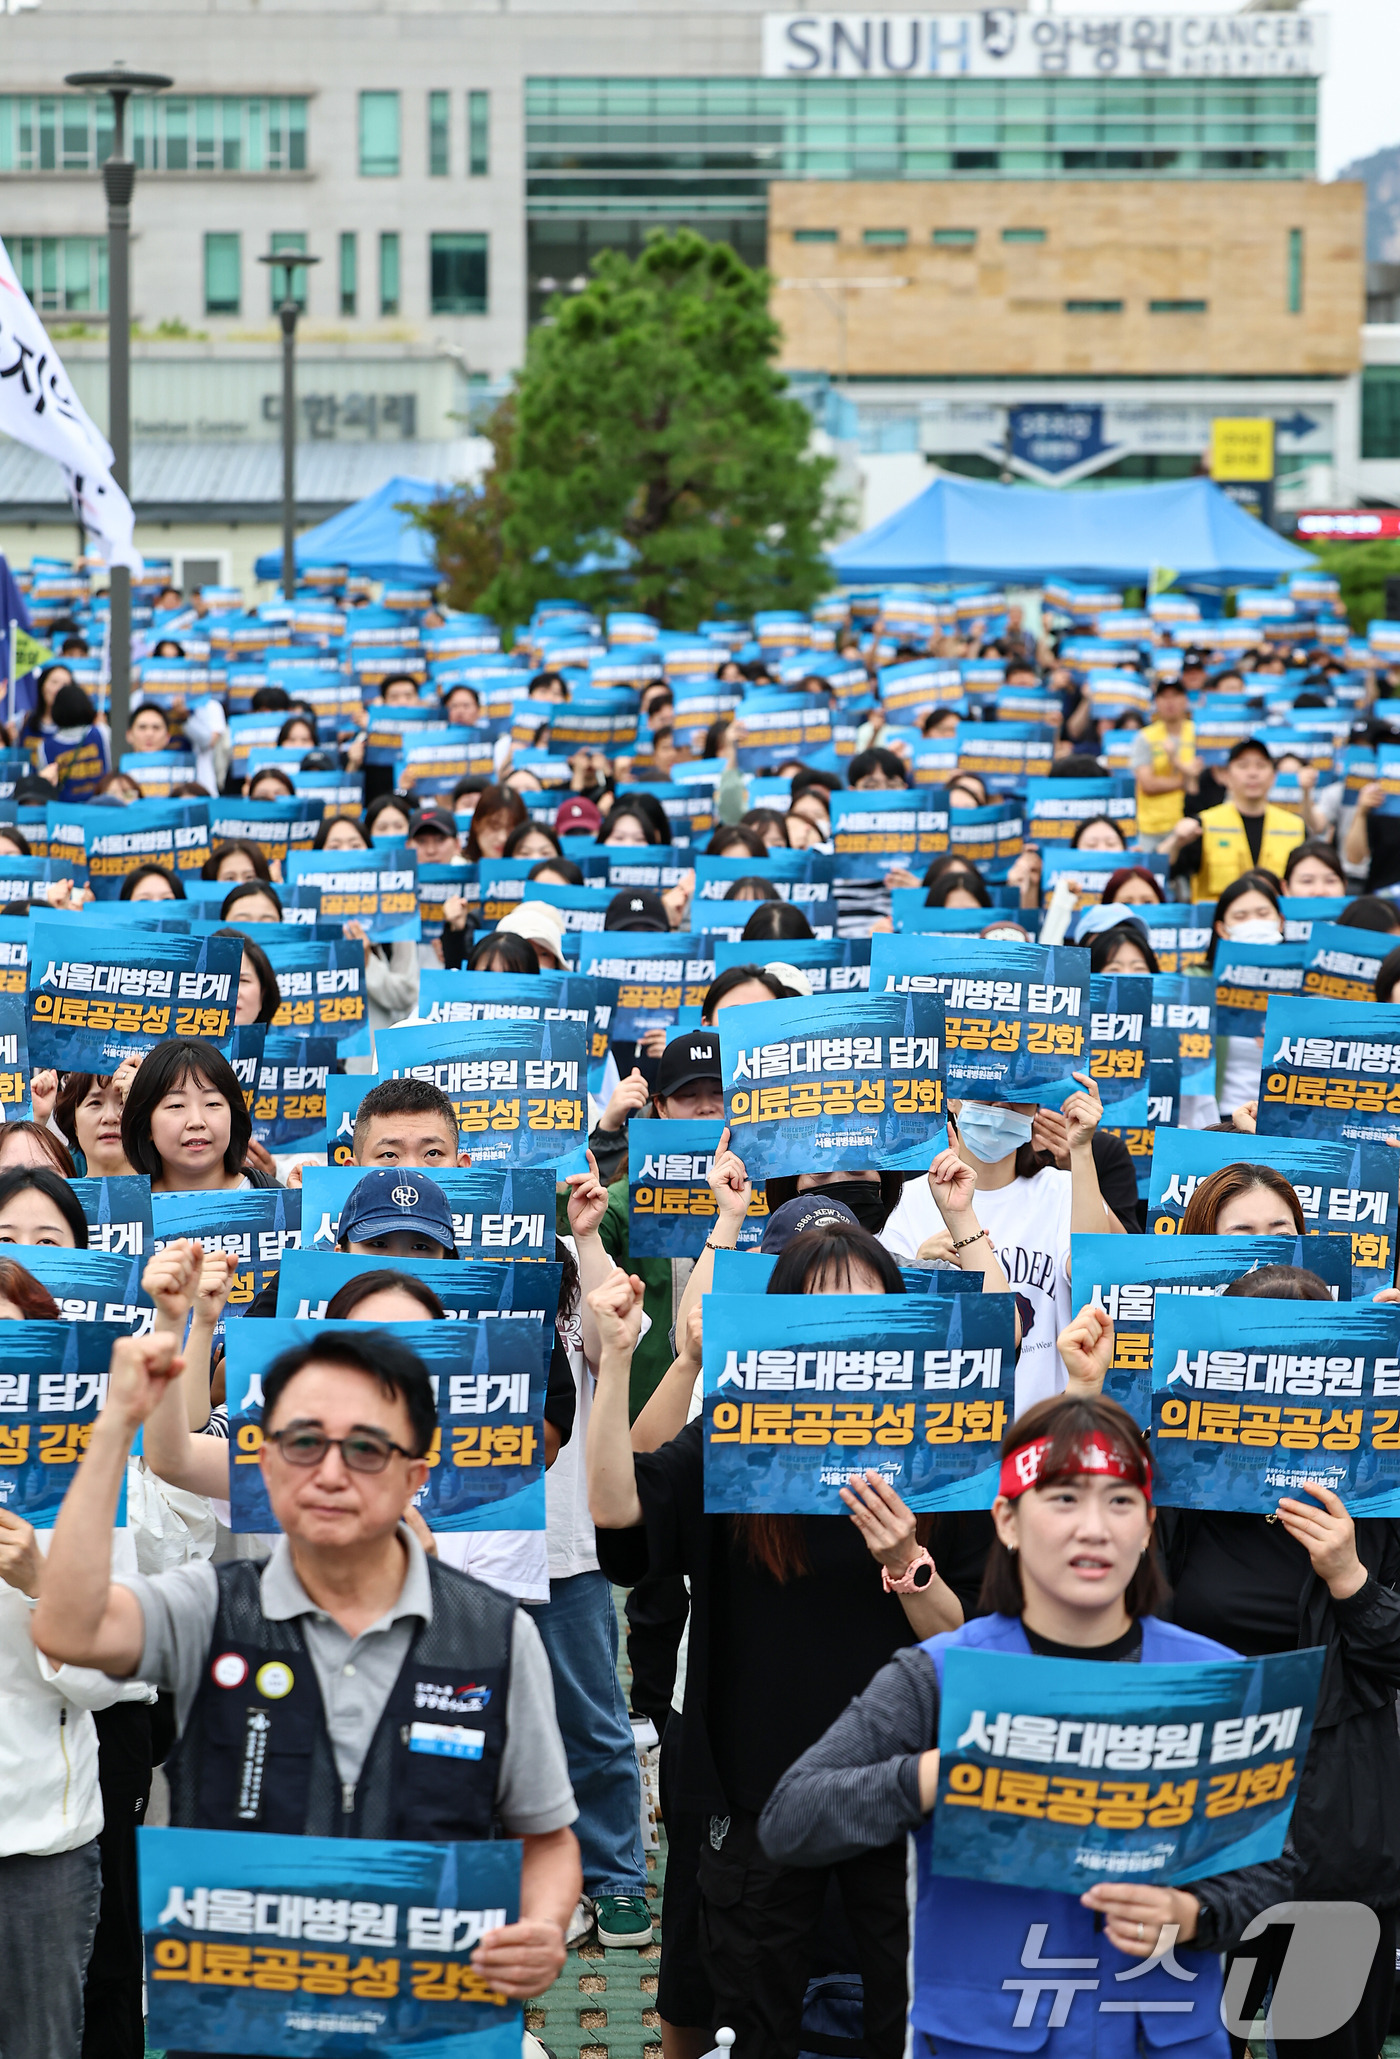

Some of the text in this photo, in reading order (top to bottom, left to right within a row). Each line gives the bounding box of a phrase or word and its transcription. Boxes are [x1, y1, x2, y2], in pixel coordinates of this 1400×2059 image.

[785, 17, 970, 72] SNUH
[1031, 18, 1170, 73] 암병원
[1180, 18, 1314, 49] CANCER
[1181, 51, 1312, 74] HOSPITAL
[90, 825, 208, 854] 서울대병원 답게
[378, 870, 414, 891] 답게
[320, 894, 378, 914] 공공성
[39, 961, 174, 998] 서울대병원
[177, 972, 232, 1001] 답게
[316, 968, 359, 993] 답게
[586, 958, 684, 982] 서울대병원
[830, 965, 871, 990] 답게
[319, 996, 365, 1022] 강화
[617, 985, 682, 1009] 공공성
[1027, 983, 1082, 1017] 답게
[31, 995, 230, 1037] 의료공공성 강화
[1090, 1013, 1144, 1042] 답게
[689, 1045, 713, 1060] NJ
[944, 1017, 1085, 1056] 공공성 강화
[525, 1060, 579, 1091] 답게
[732, 1036, 939, 1082] 서울대병원 답게
[947, 1068, 1003, 1081] 서울대병원분회
[1089, 1049, 1146, 1079] 강화
[283, 1066, 329, 1090] 답게
[527, 1098, 584, 1131] 강화
[729, 1078, 944, 1126] 의료공공성 강화
[814, 1135, 873, 1149] 서울대병원분회
[638, 1154, 717, 1182] 서울대
[633, 1185, 770, 1217] 의료공성
[1327, 1187, 1389, 1225] 답게
[480, 1214, 545, 1247] 답게
[716, 1348, 1002, 1392] 서울대병원 답게
[1166, 1349, 1365, 1397] 서울대병원
[38, 1372, 113, 1414] 답게
[449, 1373, 530, 1415] 답게
[710, 1400, 1008, 1446] 의료공공성 강화
[1157, 1399, 1364, 1450] 의료공공성
[451, 1425, 538, 1468] 강화
[957, 1707, 1302, 1770] 서울대병원 답게
[945, 1759, 1295, 1829] 의료공공성 강화
[159, 1887, 509, 1954] 서울대병원 답게
[153, 1940, 510, 2005] 의료공공성 강화
